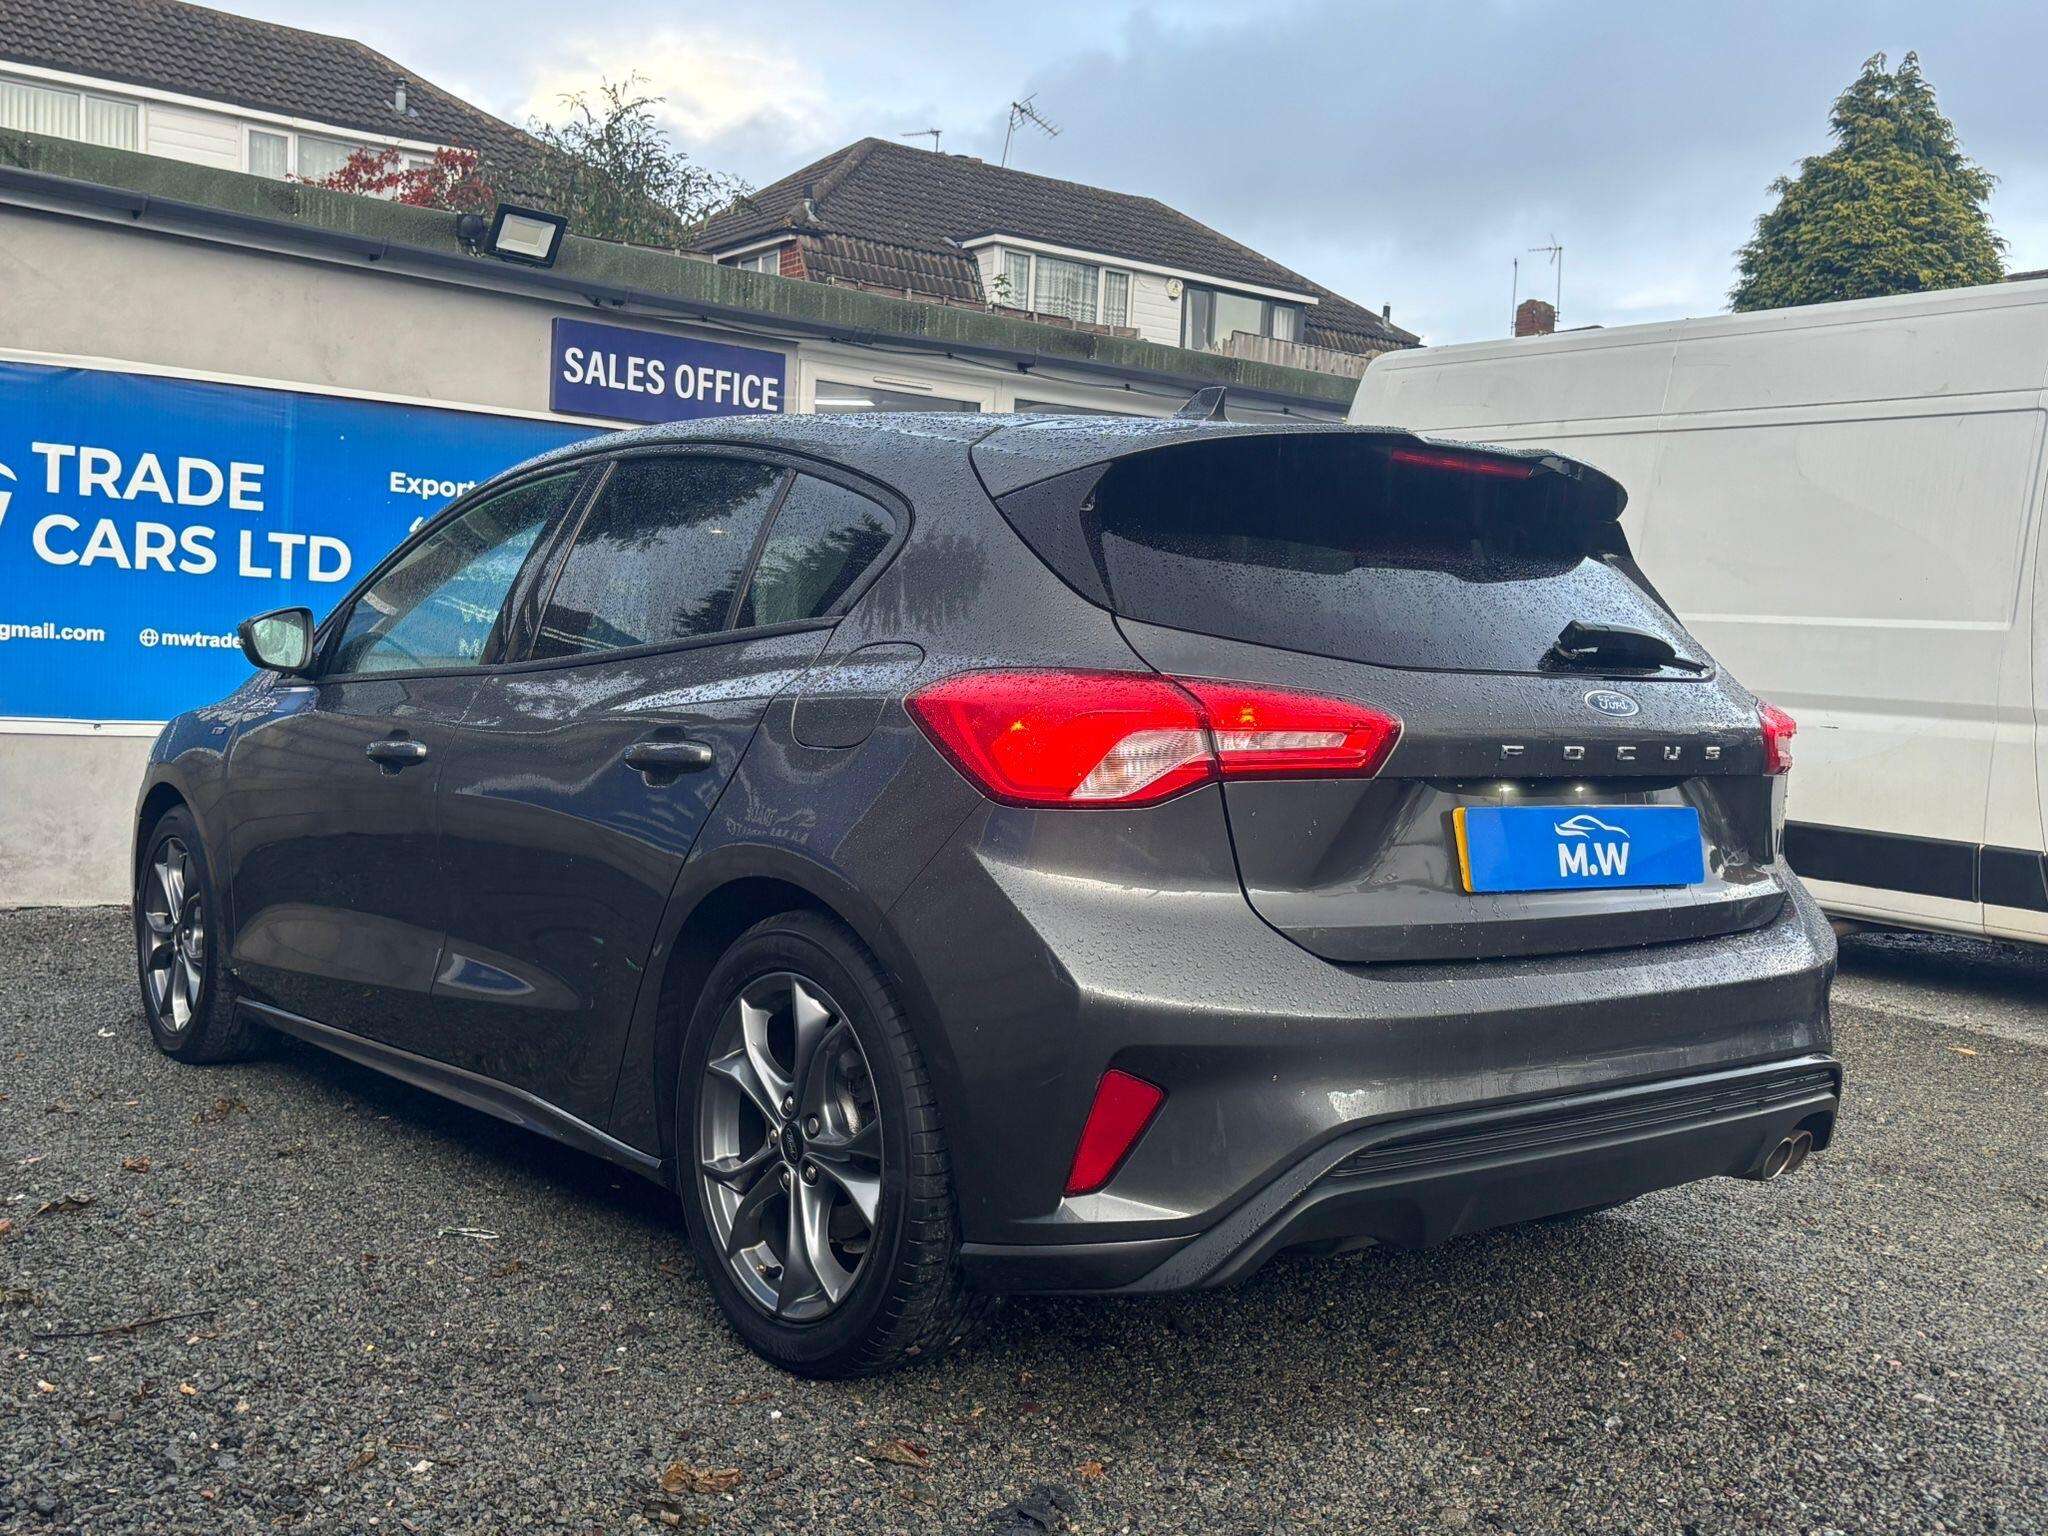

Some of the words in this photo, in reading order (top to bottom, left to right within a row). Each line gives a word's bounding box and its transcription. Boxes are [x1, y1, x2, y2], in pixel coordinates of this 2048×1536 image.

[563, 347, 666, 395] SALES
[674, 364, 779, 411] OFFICE
[31, 441, 265, 511] TRADE
[32, 513, 217, 574] CARS
[239, 529, 352, 582] LTD
[1500, 745, 1721, 761] FOCUS
[1557, 842, 1630, 877] M.W
